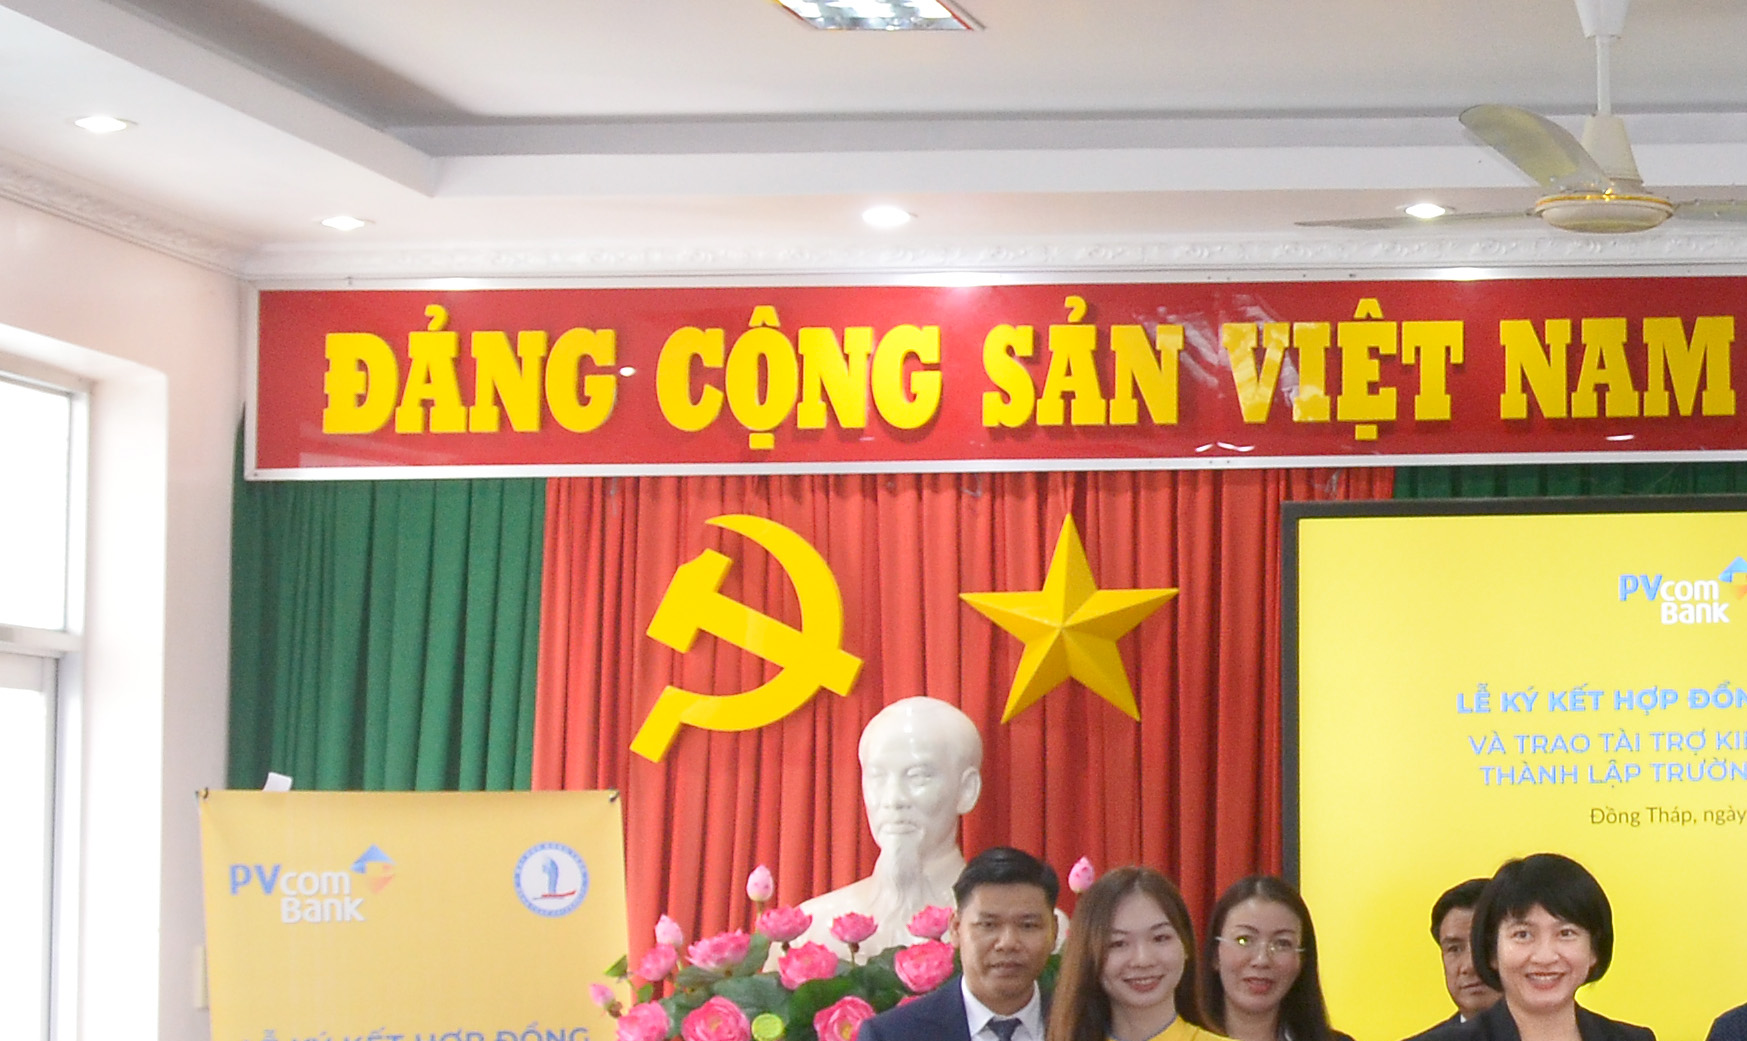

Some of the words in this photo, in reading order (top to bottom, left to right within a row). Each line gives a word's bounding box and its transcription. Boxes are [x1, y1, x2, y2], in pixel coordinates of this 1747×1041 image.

[324, 304, 616, 434] ĐẢNG
[655, 306, 941, 449] CỘNG
[982, 296, 1182, 428] SẢN
[1221, 298, 1463, 441] VIỆT
[1500, 315, 1736, 419] NAM
[1619, 574, 1719, 601] PVcom
[1661, 601, 1730, 625] Bank
[1457, 682, 1491, 713] LỄ
[1500, 687, 1538, 713] KÝ
[1548, 683, 1604, 712] KẾT
[1614, 686, 1679, 715] HỢP
[1468, 730, 1506, 755] VÀ
[1514, 734, 1590, 754] TRAO
[1599, 728, 1640, 752] TÀI
[1651, 728, 1706, 755] TRỢ
[1479, 762, 1578, 786] THÀNH
[1588, 759, 1641, 788] LẬP
[1590, 806, 1640, 826] Đồng
[1647, 806, 1697, 825] Tháp,
[1703, 805, 1747, 826] ngày
[228, 863, 351, 898] PVcom
[280, 896, 366, 924] Bank
